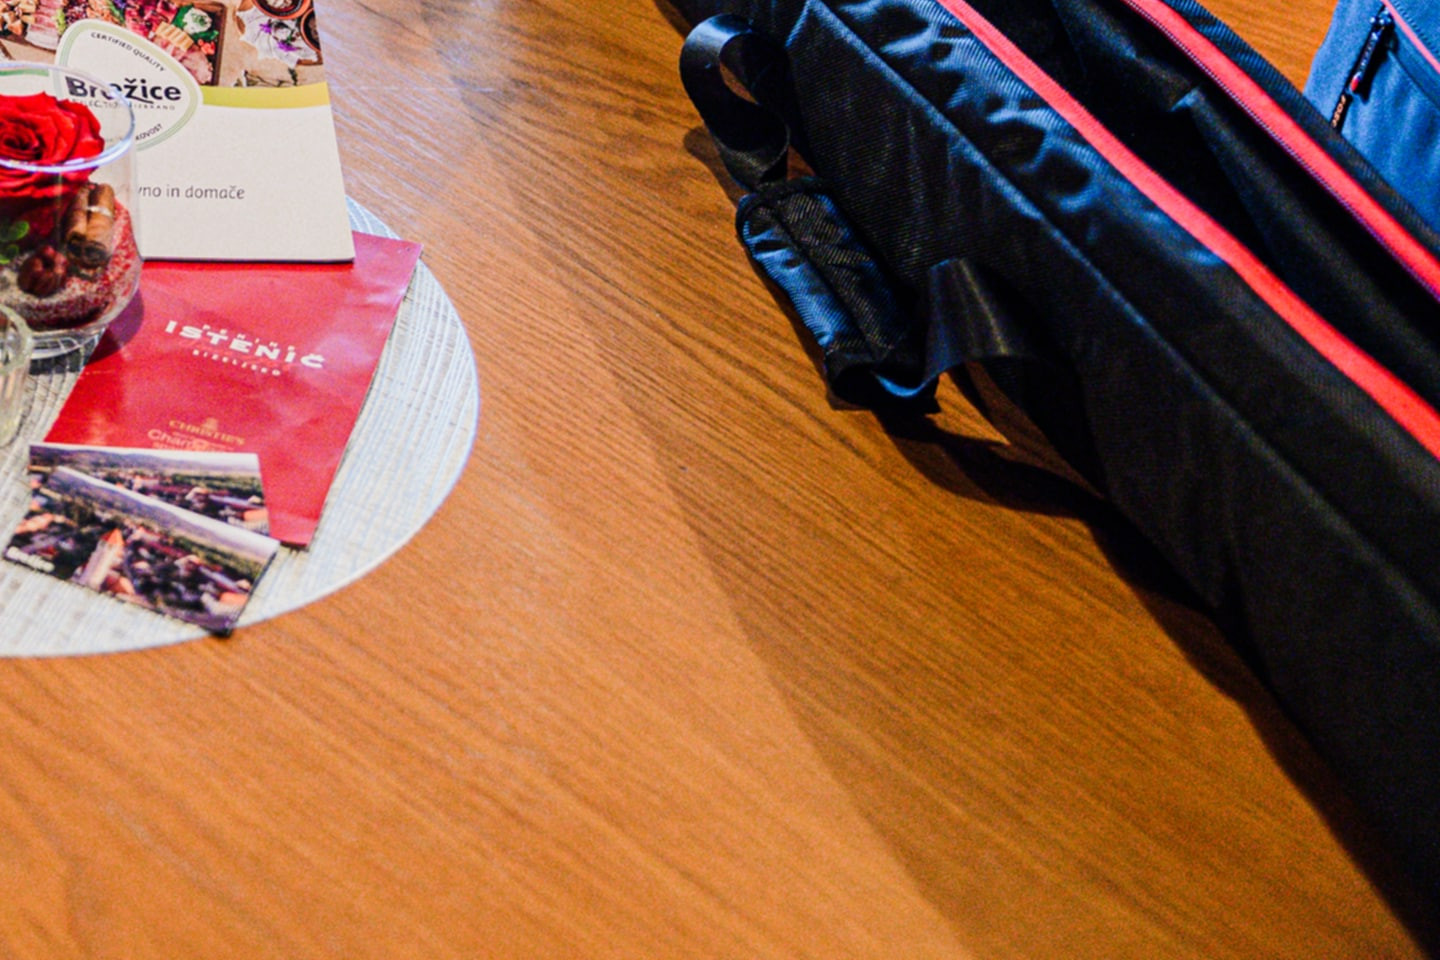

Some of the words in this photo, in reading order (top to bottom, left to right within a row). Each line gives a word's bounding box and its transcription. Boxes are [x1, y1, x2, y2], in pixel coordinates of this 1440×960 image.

[90, 31, 133, 52] CERTIFIED
[132, 47, 165, 72] QUALITY
[166, 184, 180, 198] in
[184, 185, 245, 200] domače
[165, 320, 325, 368] ISTENIČ
